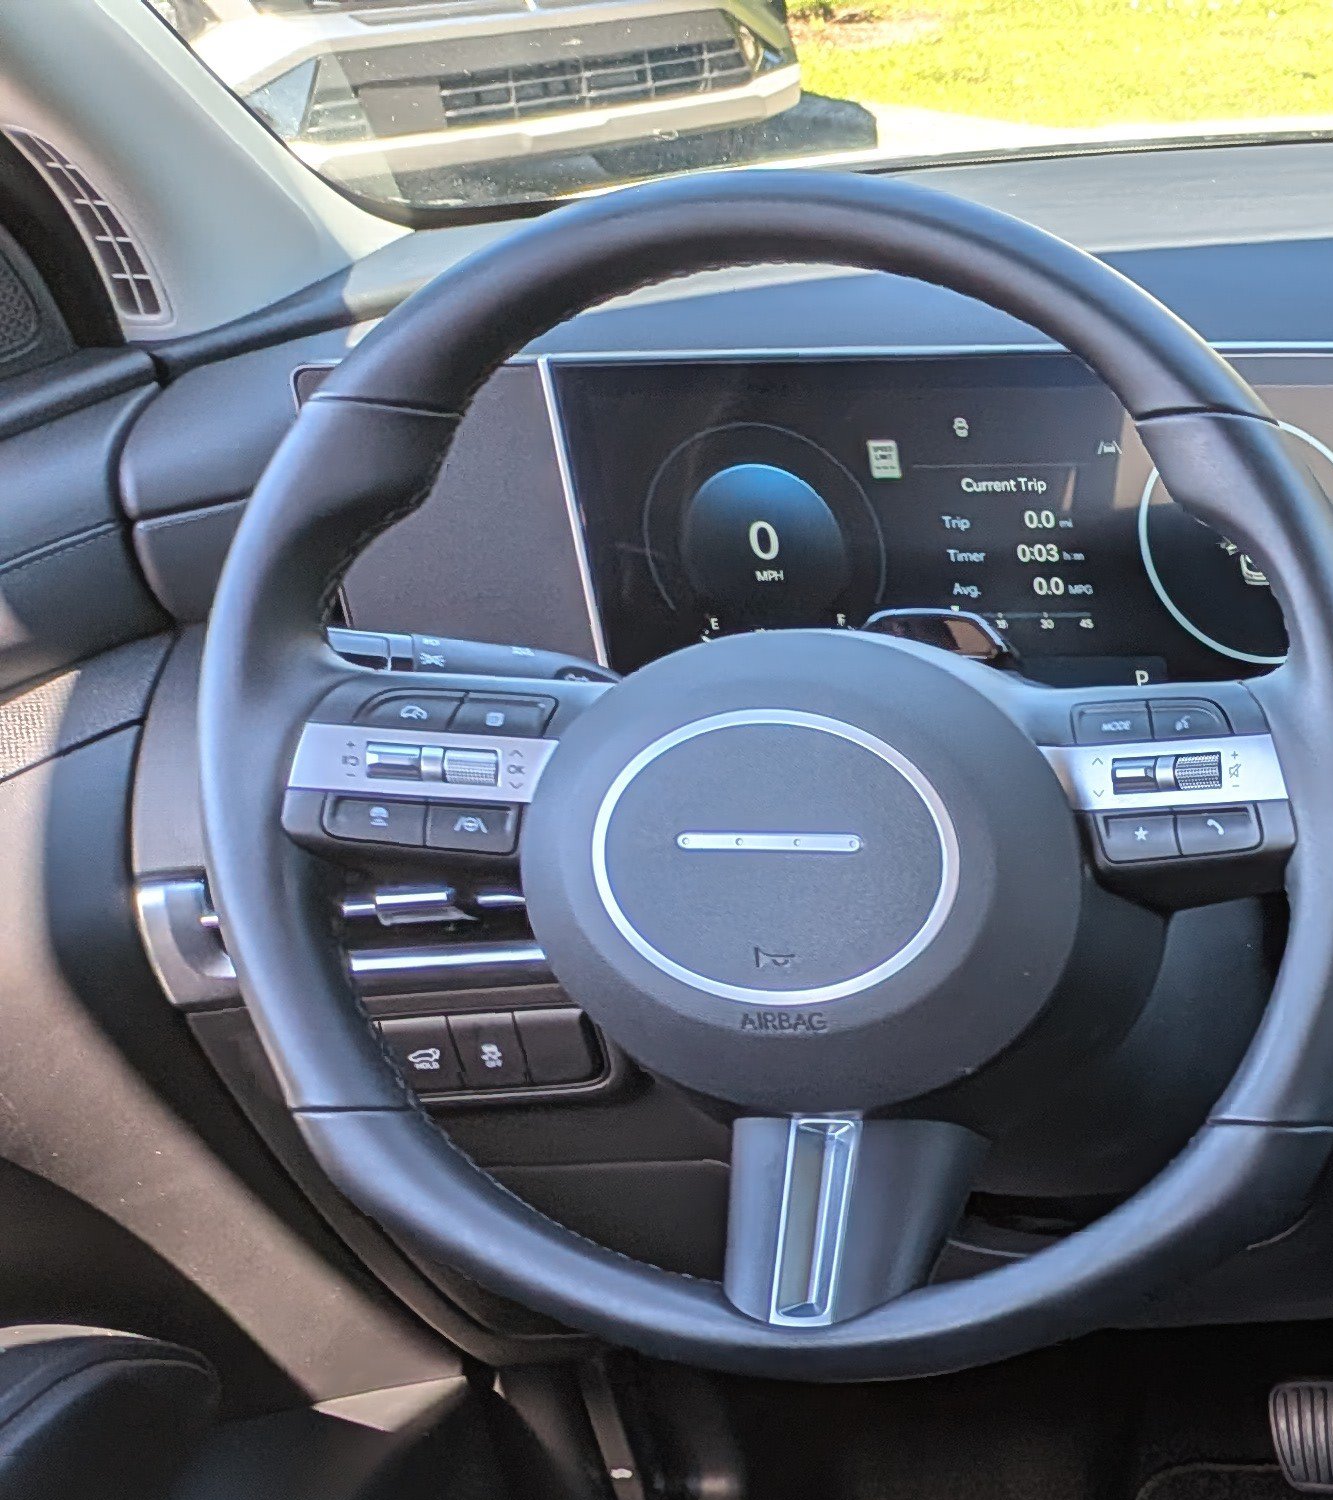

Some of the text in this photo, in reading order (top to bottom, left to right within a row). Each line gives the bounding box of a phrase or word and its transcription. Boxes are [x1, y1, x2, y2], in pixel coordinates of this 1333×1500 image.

[960, 477, 1047, 495] Current Trip
[941, 515, 971, 531] Trip
[1023, 510, 1056, 529] 0.0
[749, 520, 780, 561] 0
[946, 548, 986, 564] Timer
[1016, 544, 1060, 563] 0:03
[755, 569, 785, 582] MPH
[952, 576, 1094, 598] Avg. 0.0 MPG
[710, 617, 720, 631] E
[1134, 669, 1149, 687] P
[1101, 719, 1132, 732] MODE
[740, 1011, 829, 1032] AIRBAG
